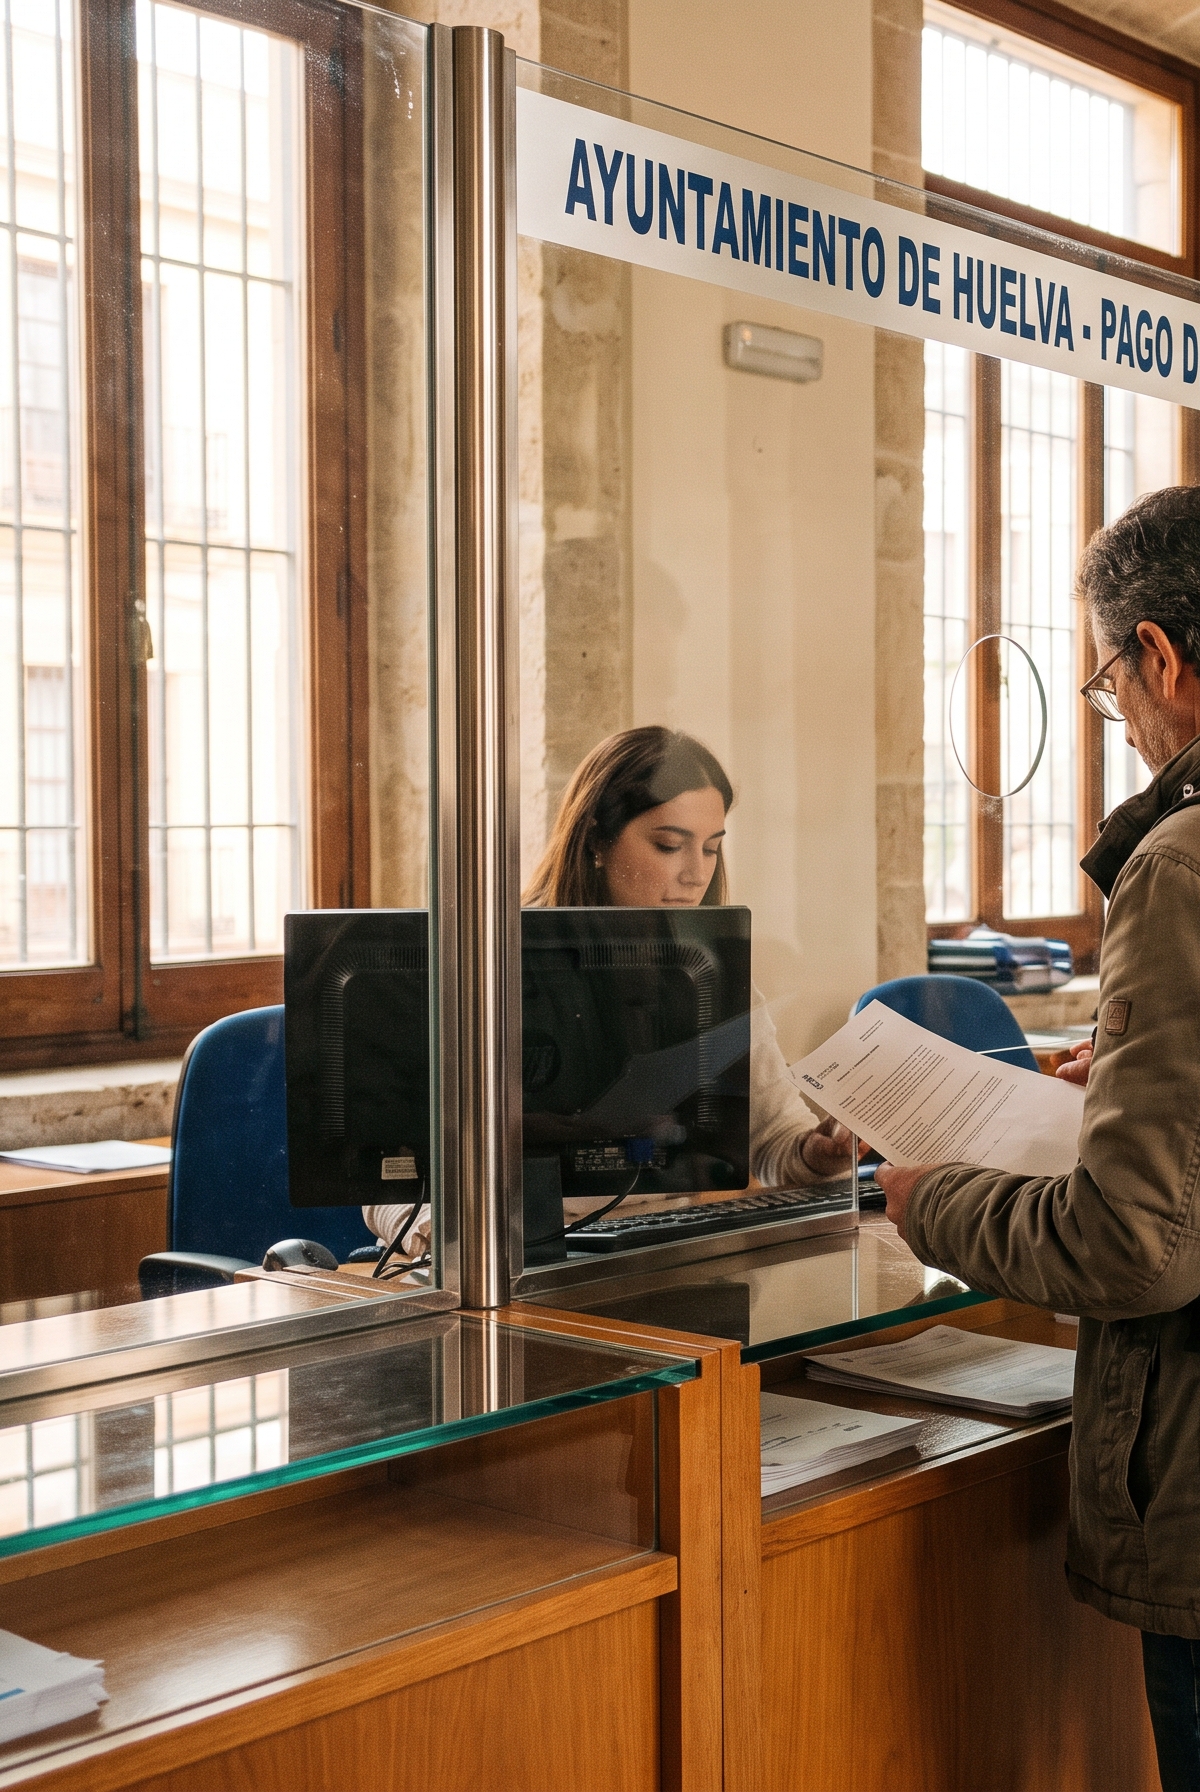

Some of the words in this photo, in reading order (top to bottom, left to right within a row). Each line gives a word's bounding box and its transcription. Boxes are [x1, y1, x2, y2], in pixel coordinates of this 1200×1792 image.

[564, 137, 886, 299] AYUNTAMIENTO
[898, 235, 941, 315] DE
[953, 252, 1074, 352] HUELVA
[1101, 297, 1174, 378] PAGO
